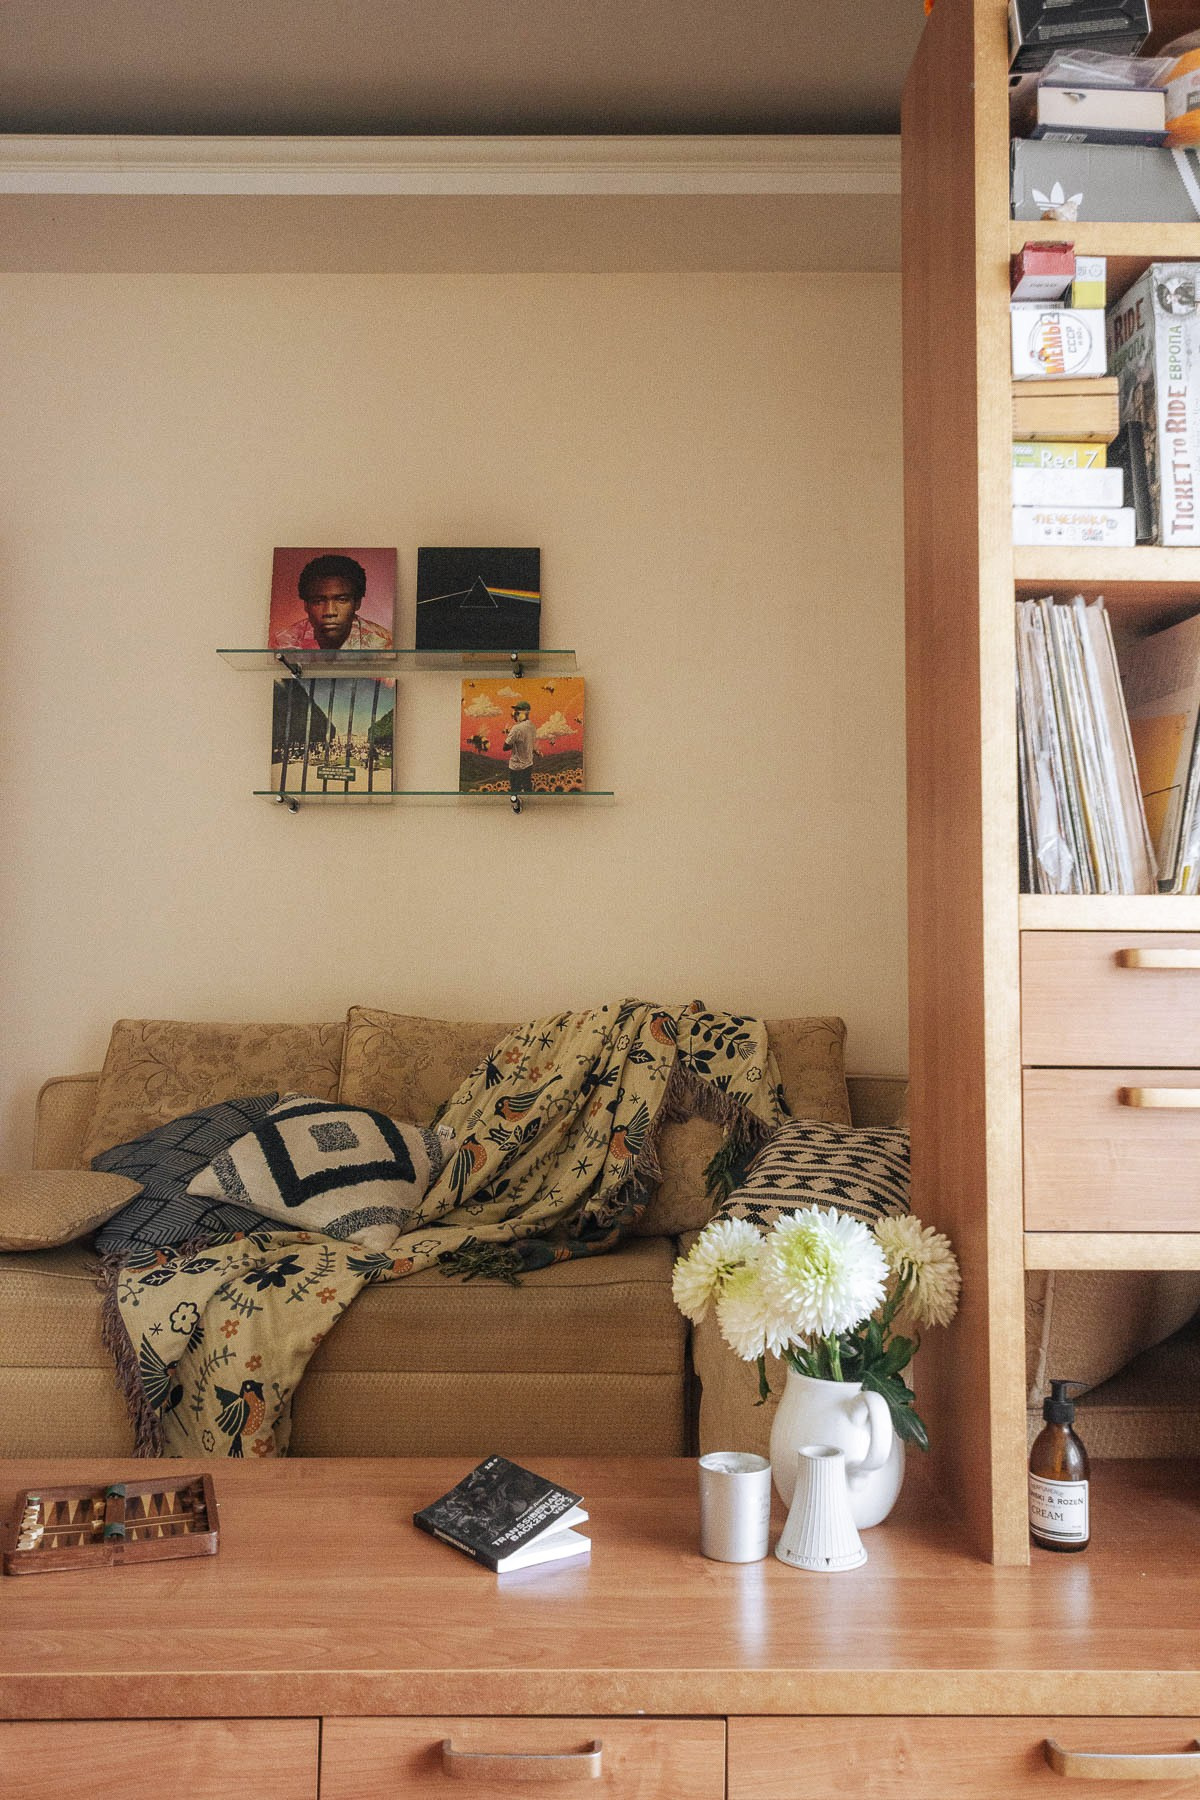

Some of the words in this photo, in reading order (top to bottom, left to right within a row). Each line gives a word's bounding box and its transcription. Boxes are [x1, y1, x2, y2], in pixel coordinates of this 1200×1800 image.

[1168, 325, 1182, 380] ЕВРОПА
[1165, 385, 1187, 433] RIDE
[1041, 450, 1078, 468] Red
[1084, 450, 1099, 468] 7
[1171, 460, 1194, 535] TICKET
[491, 1491, 562, 1546] TRANSSIBERIAN
[1031, 1504, 1064, 1521] CREAM
[1047, 1495, 1054, 1504] &
[1057, 1497, 1084, 1506] ROZEN
